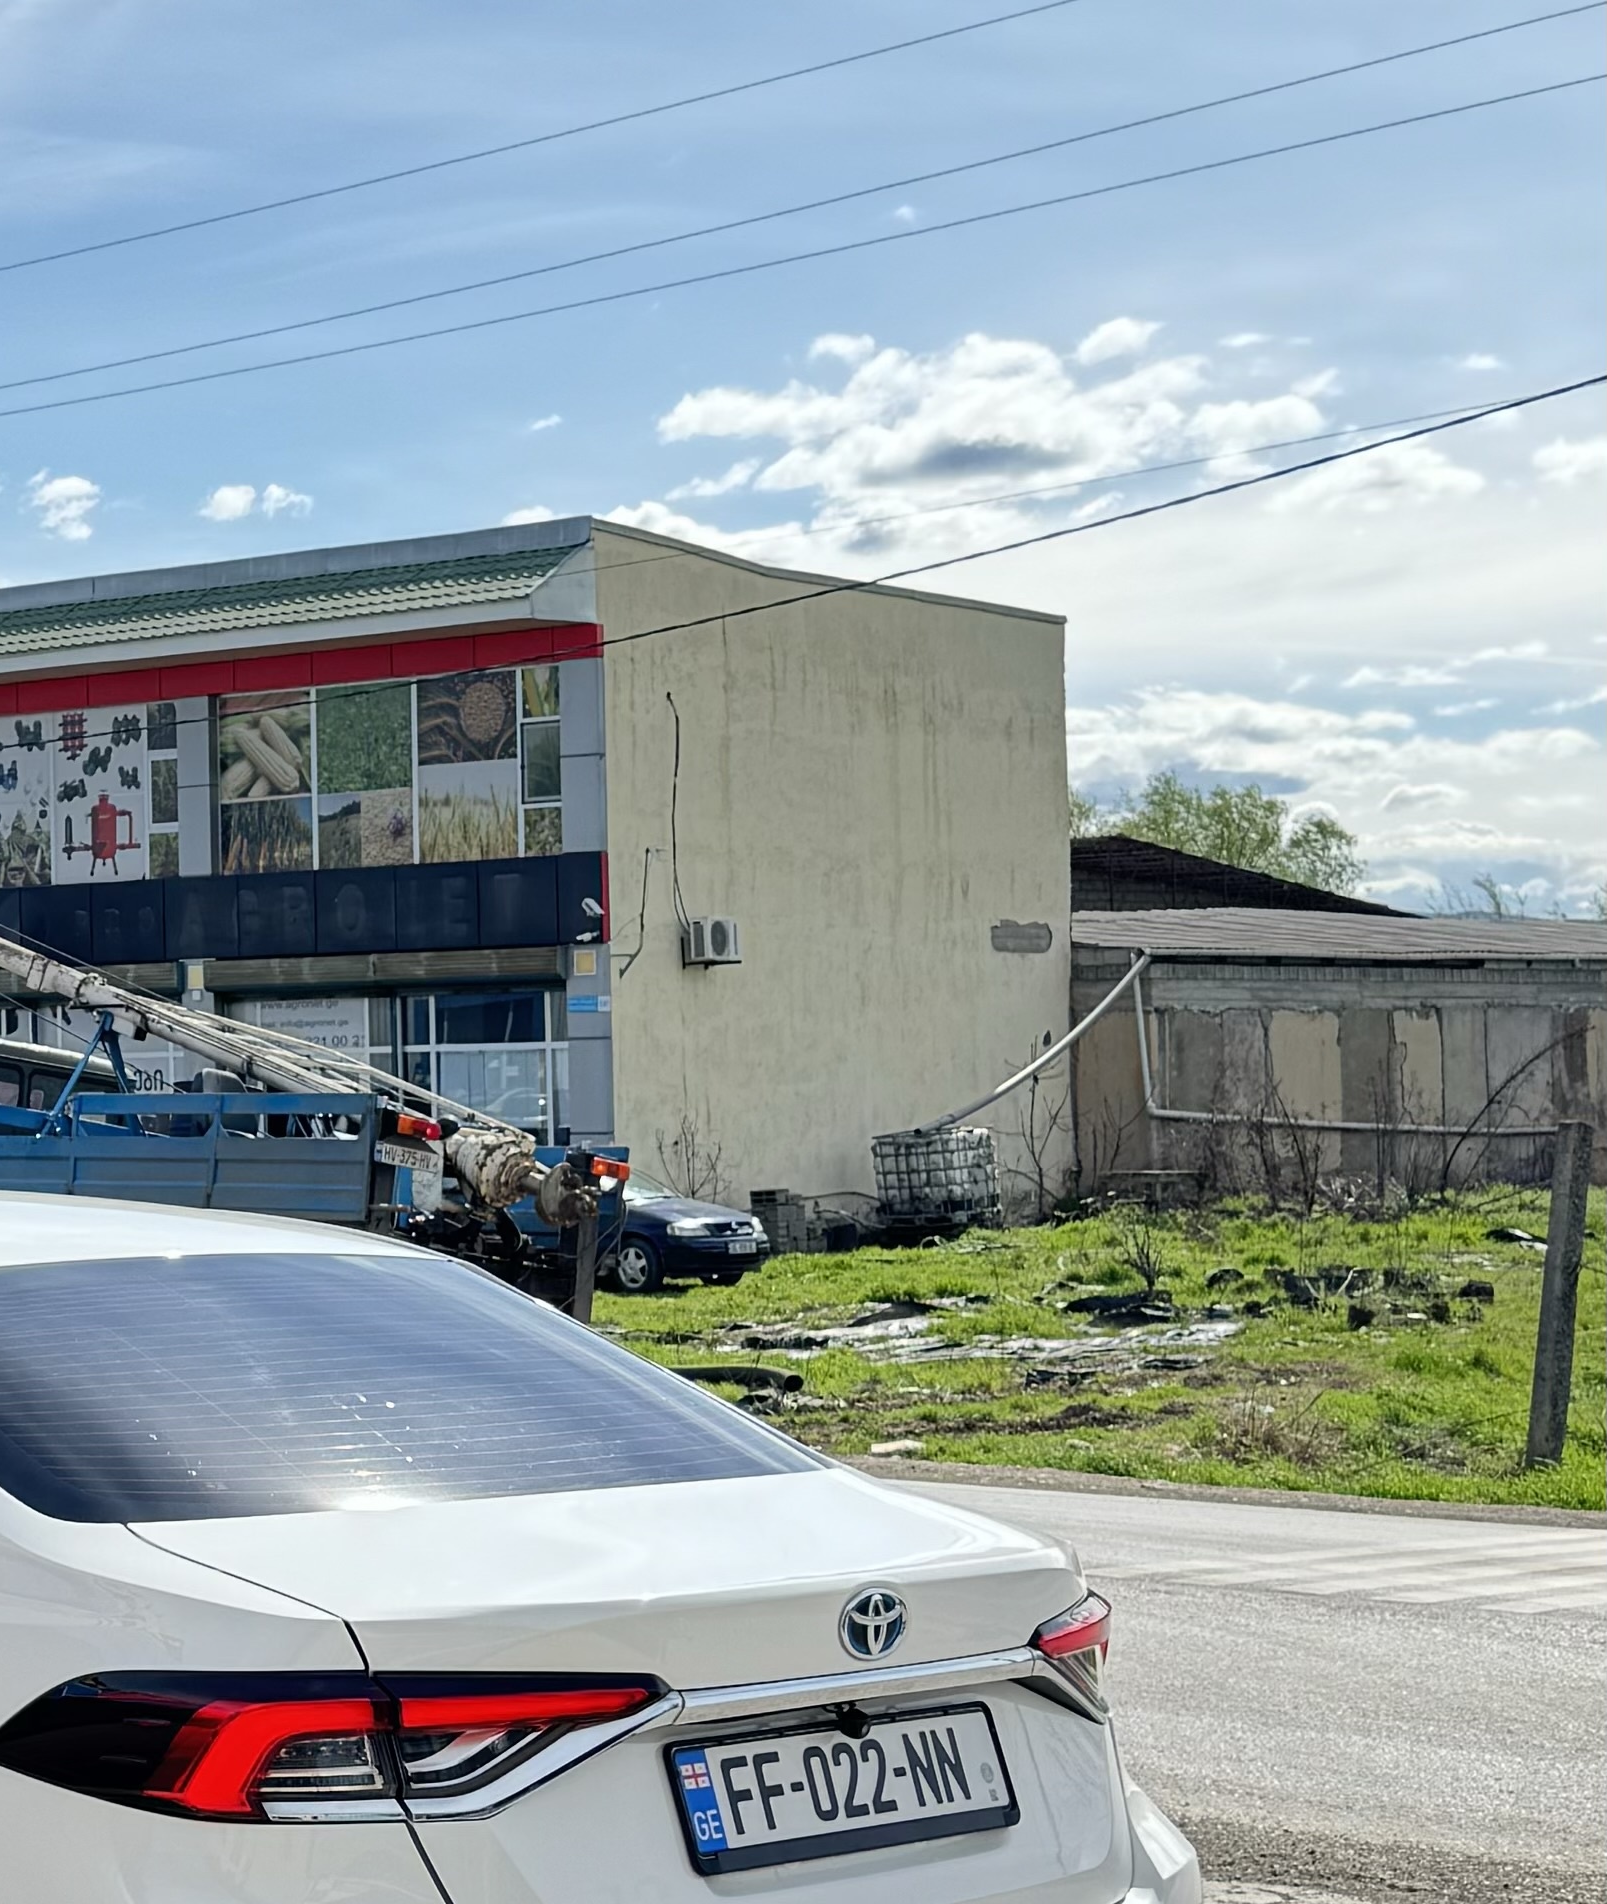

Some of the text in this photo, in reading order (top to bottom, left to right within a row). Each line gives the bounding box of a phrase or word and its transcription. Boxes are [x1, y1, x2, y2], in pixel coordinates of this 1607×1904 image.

[384, 1145, 432, 1169] HV-375-HV
[720, 1727, 972, 1836] FF-022-NN
[694, 1809, 723, 1842] GE
